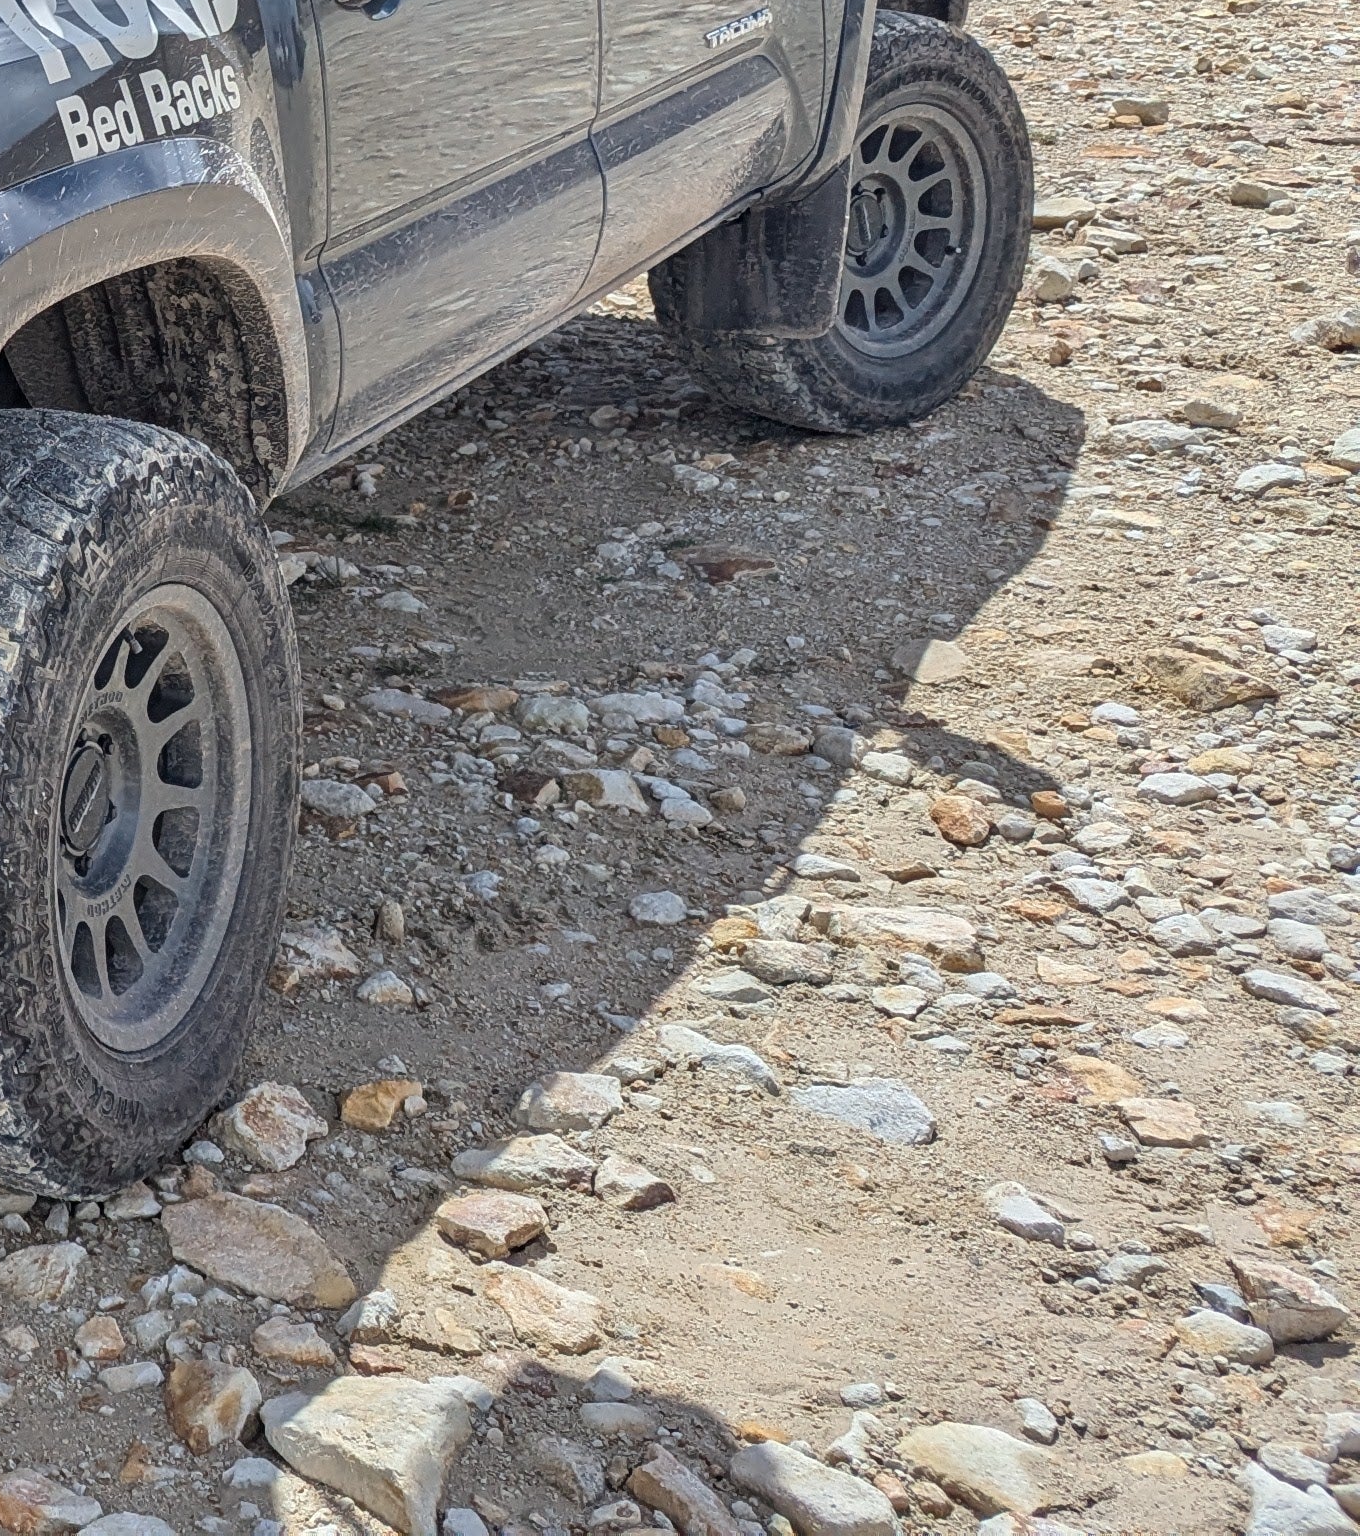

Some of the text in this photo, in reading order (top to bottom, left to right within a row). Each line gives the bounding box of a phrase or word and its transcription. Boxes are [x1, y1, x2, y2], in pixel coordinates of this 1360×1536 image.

[704, 7, 773, 48] TACOMA
[56, 62, 242, 163] Bed Racks
[36, 776, 64, 1037] THOMPSON
